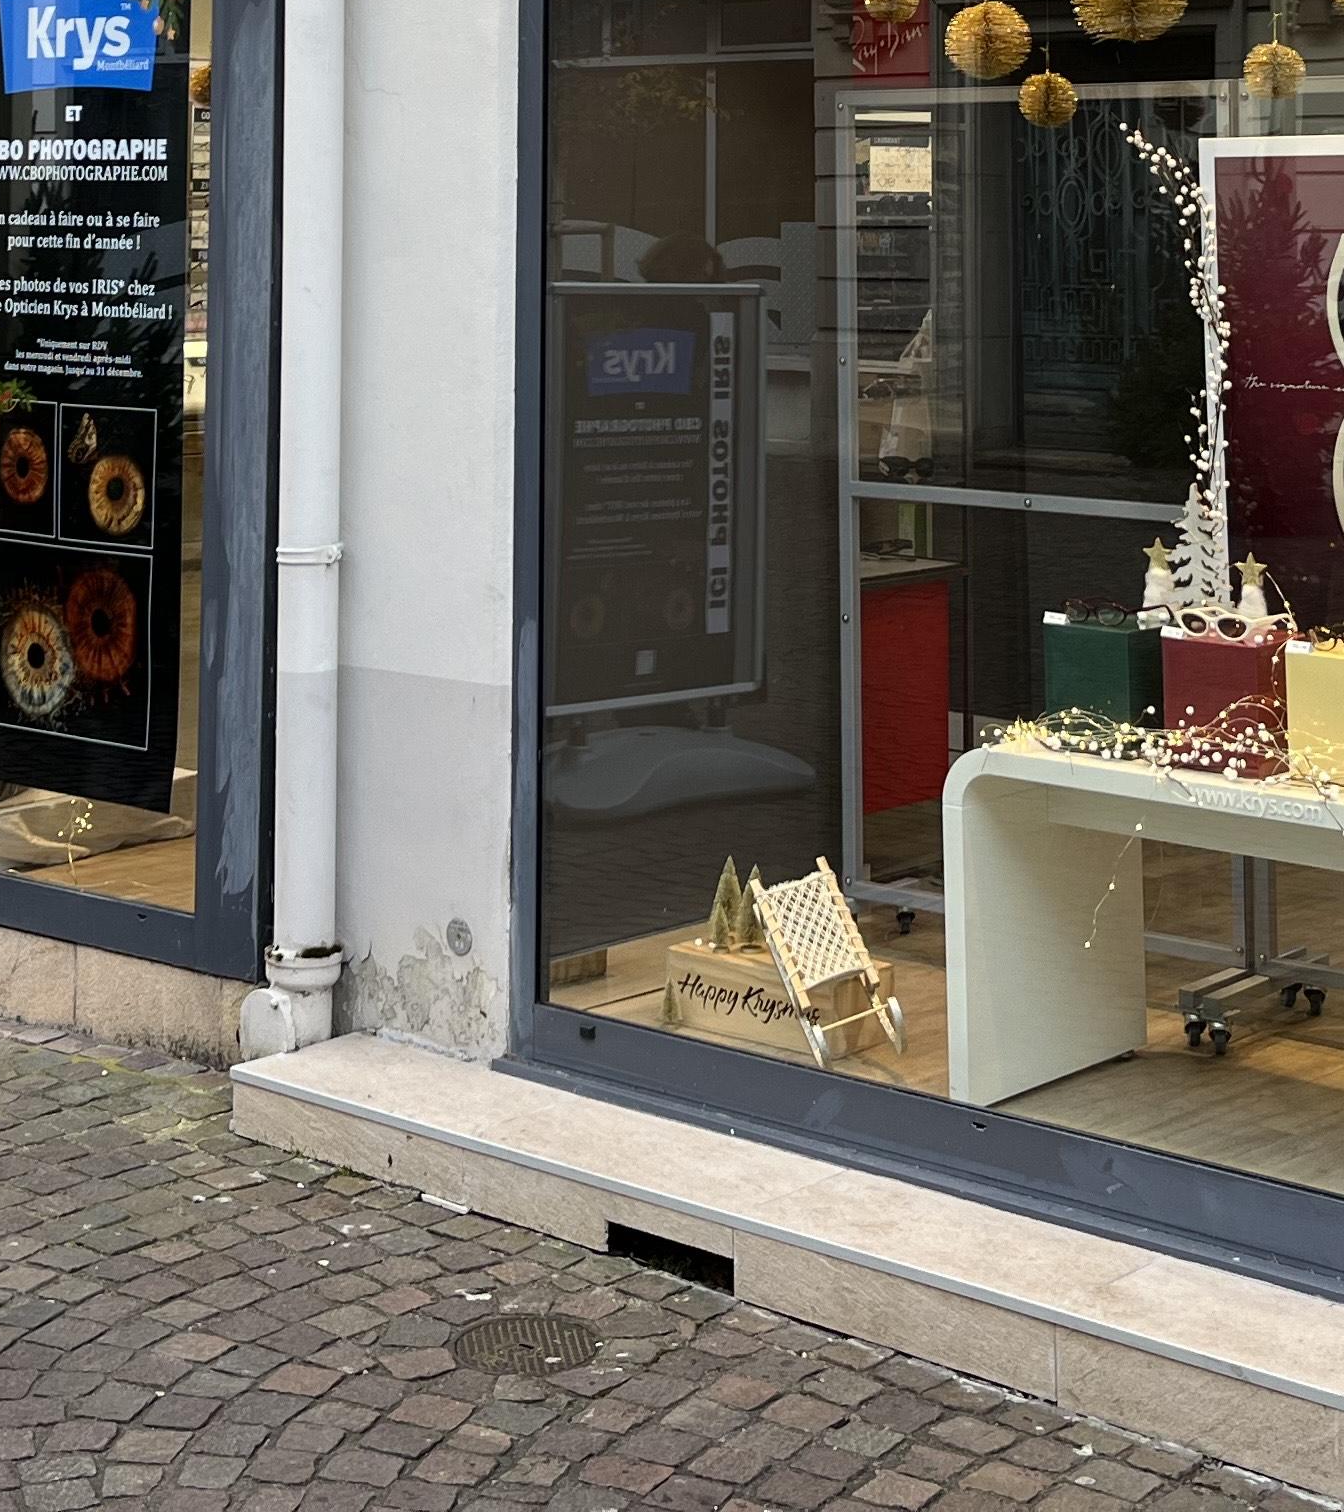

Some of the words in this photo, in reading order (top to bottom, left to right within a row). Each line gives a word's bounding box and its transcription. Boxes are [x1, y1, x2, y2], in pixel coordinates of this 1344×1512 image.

[27, 6, 132, 71] Krys
[65, 104, 84, 123] ET
[27, 138, 167, 162] PHOTOGRAPHE
[8, 210, 47, 227] cadeau
[49, 210, 56, 227] à
[57, 210, 84, 227] faire
[86, 214, 103, 228] ou
[106, 211, 114, 228] à
[116, 215, 131, 228] se
[133, 212, 161, 229] faire
[7, 234, 37, 252] pour
[37, 235, 63, 249] cette
[65, 232, 81, 249] fin
[83, 233, 134, 251] d'année
[13, 275, 51, 296] photos
[53, 276, 66, 294] de
[68, 280, 89, 295] vos
[127, 279, 156, 297] chez
[4, 298, 51, 318] Opticien
[53, 299, 79, 320] Krys
[80, 300, 89, 318] à
[91, 300, 167, 320] Montbéliard
[20, 363, 36, 373] votre
[26, 350, 54, 361] mercredi
[62, 352, 92, 364] vendredi
[93, 353, 132, 365] après-midi
[1189, 786, 1323, 821] www.krys.com
[676, 972, 740, 1016] Happy
